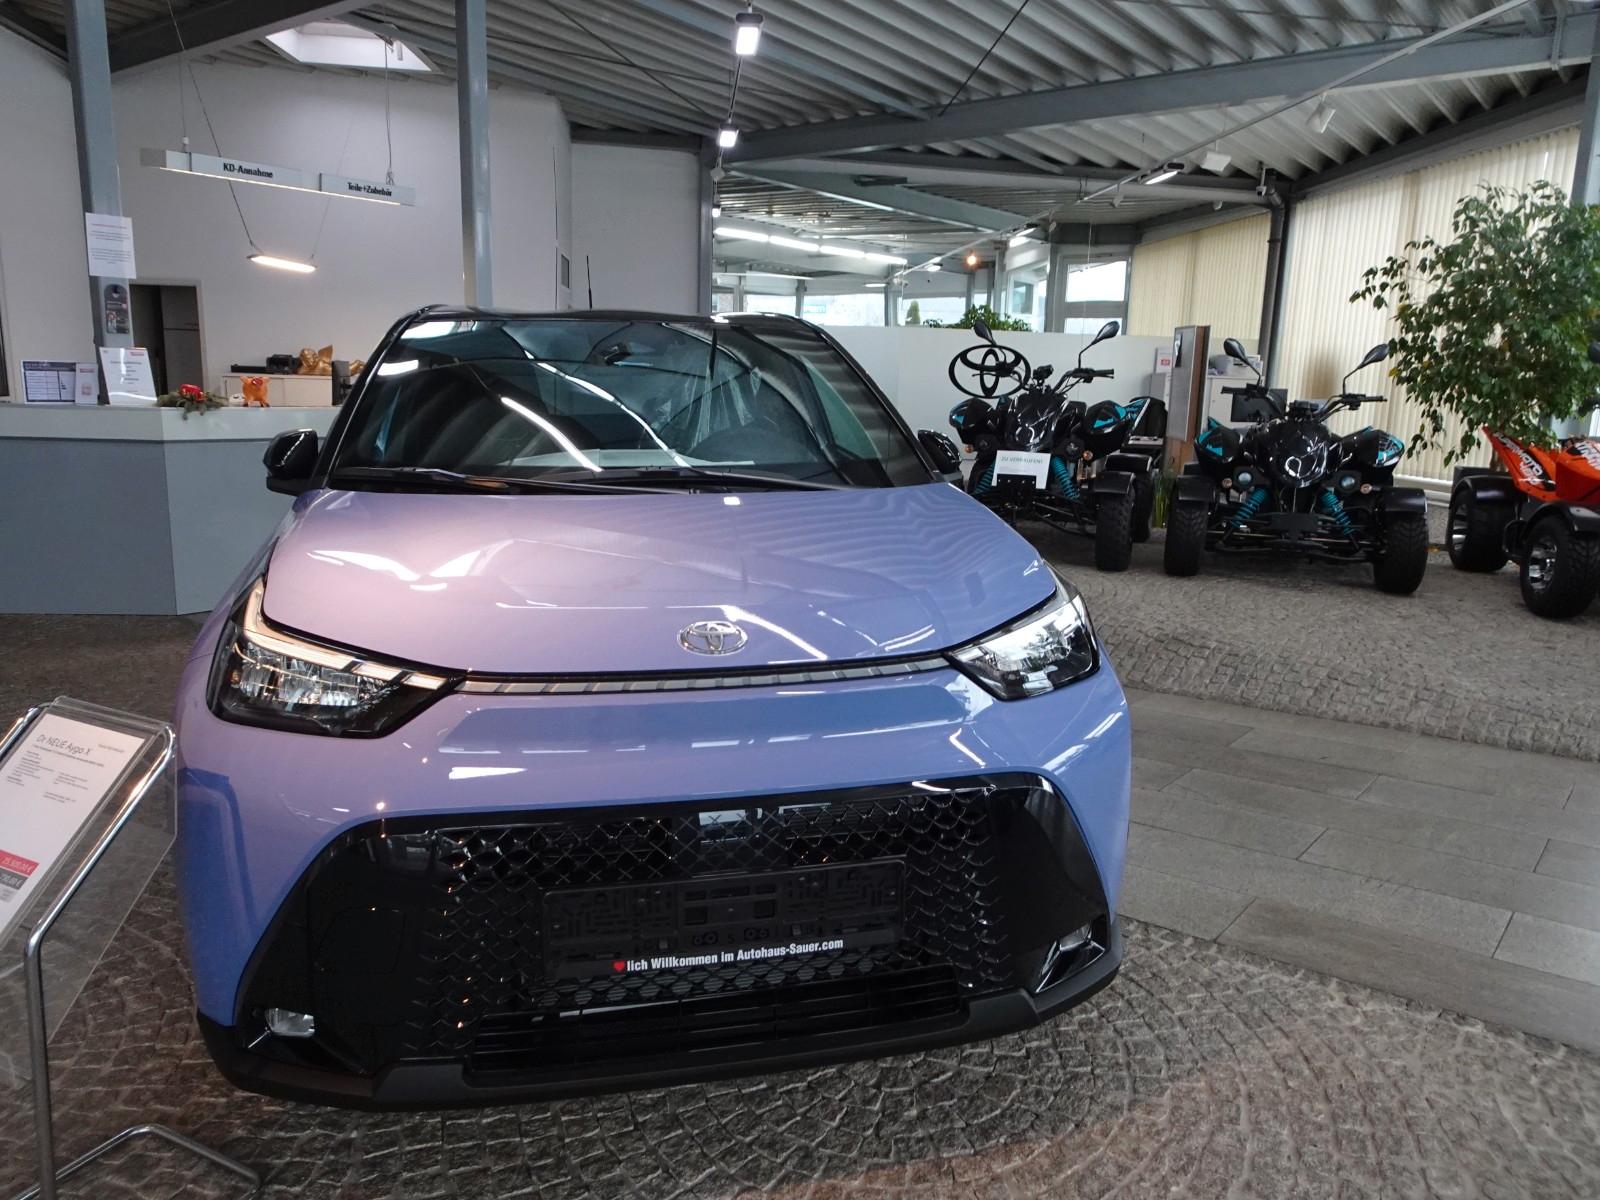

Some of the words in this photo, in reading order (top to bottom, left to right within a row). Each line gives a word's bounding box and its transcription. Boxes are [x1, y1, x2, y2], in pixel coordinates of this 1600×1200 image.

[223, 162, 274, 179] KD-Annahme
[650, 954, 718, 970] Willkommen
[720, 951, 735, 963] im
[736, 939, 844, 961] Autohaus-Sauer.com
